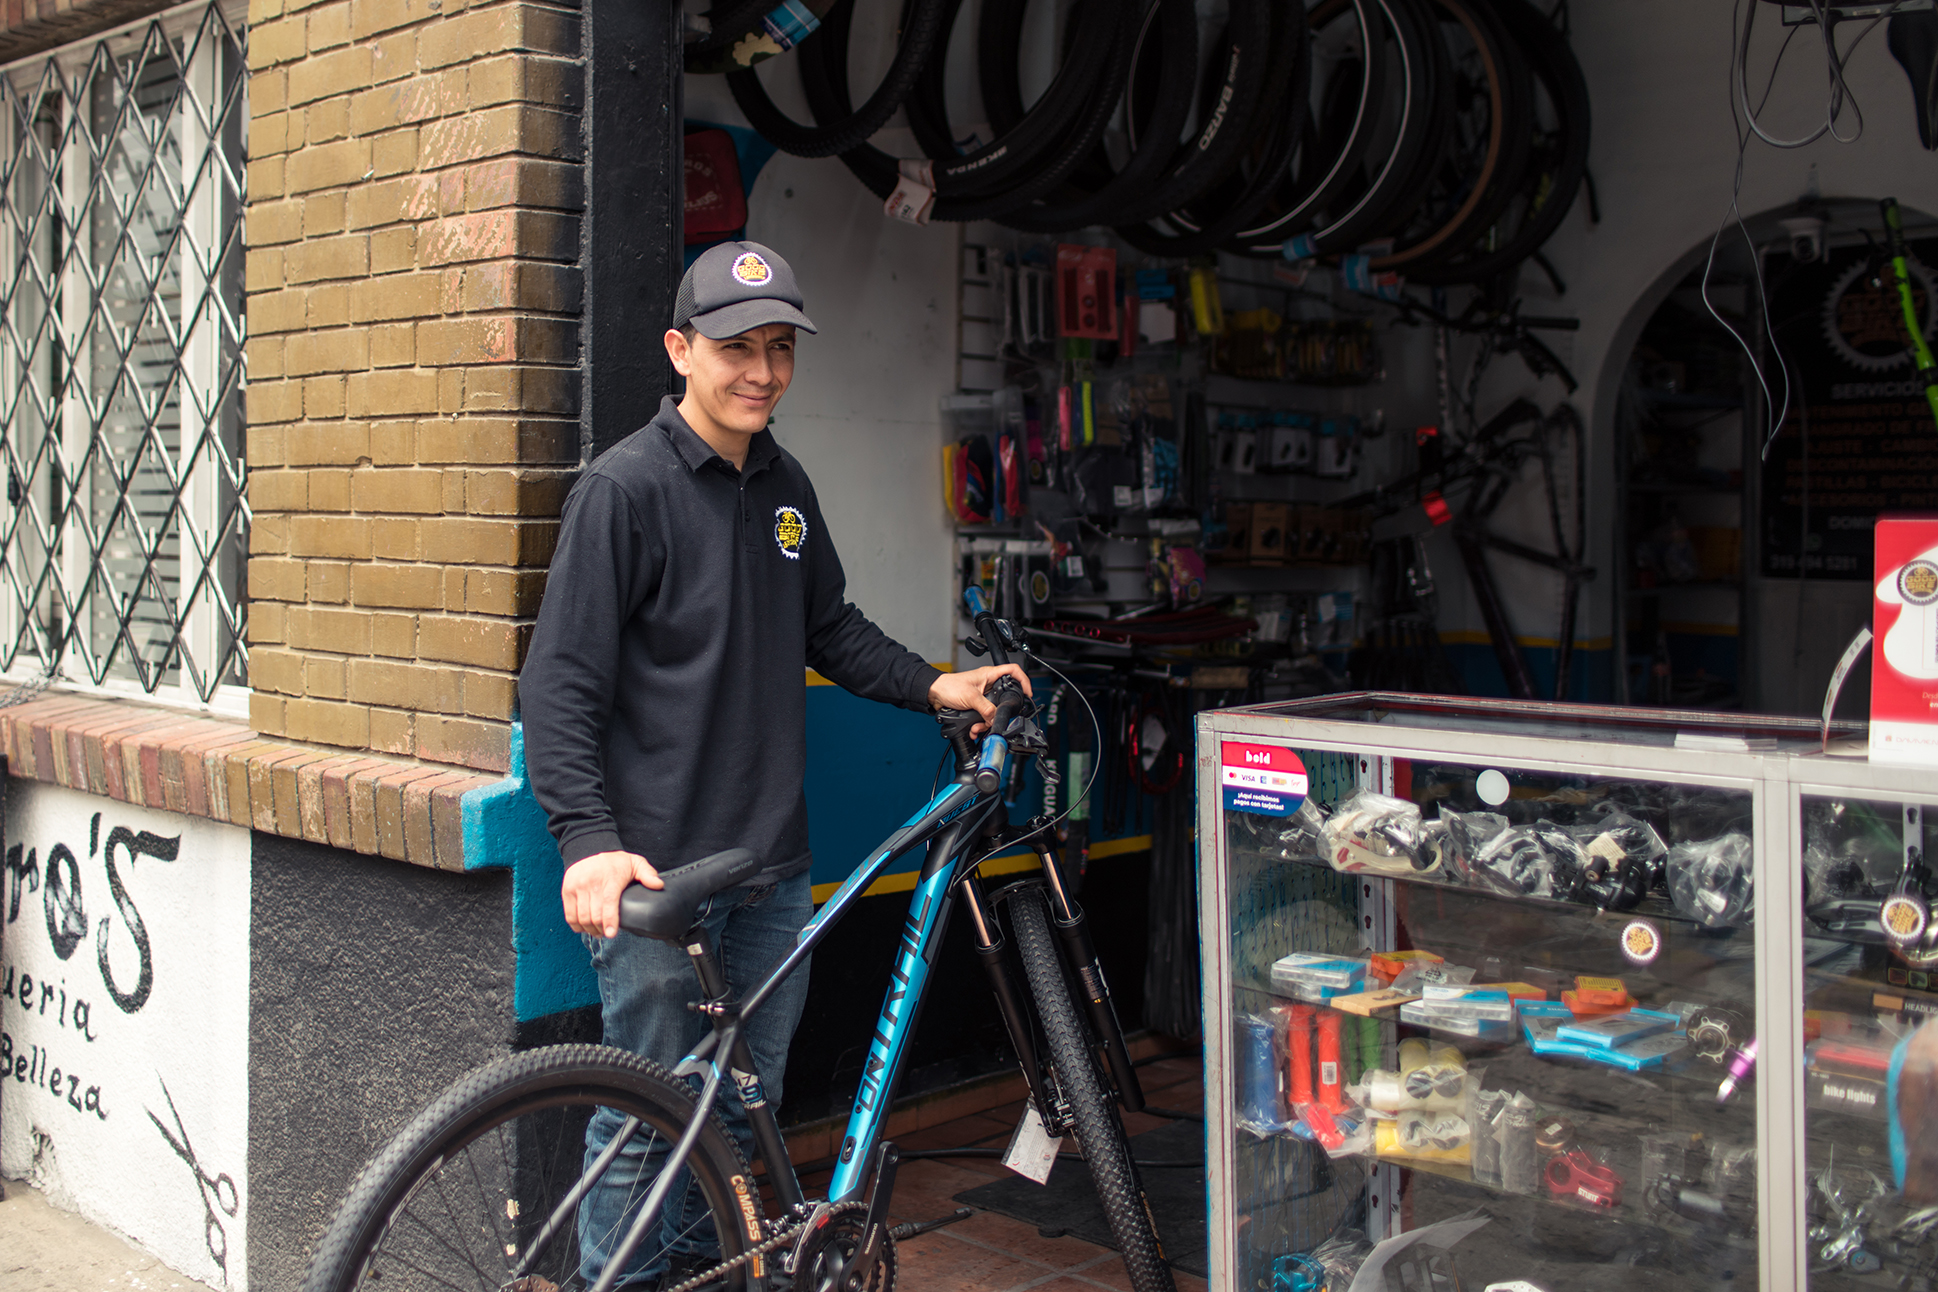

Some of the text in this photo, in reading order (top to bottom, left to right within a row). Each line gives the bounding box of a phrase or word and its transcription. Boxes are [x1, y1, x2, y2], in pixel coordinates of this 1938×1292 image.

[1245, 750, 1271, 765] bold
[1241, 774, 1256, 782] VISA
[859, 894, 932, 1112] ONTRAIL
[1823, 1084, 1876, 1105] bike lights
[731, 1174, 762, 1242] COMPASS
